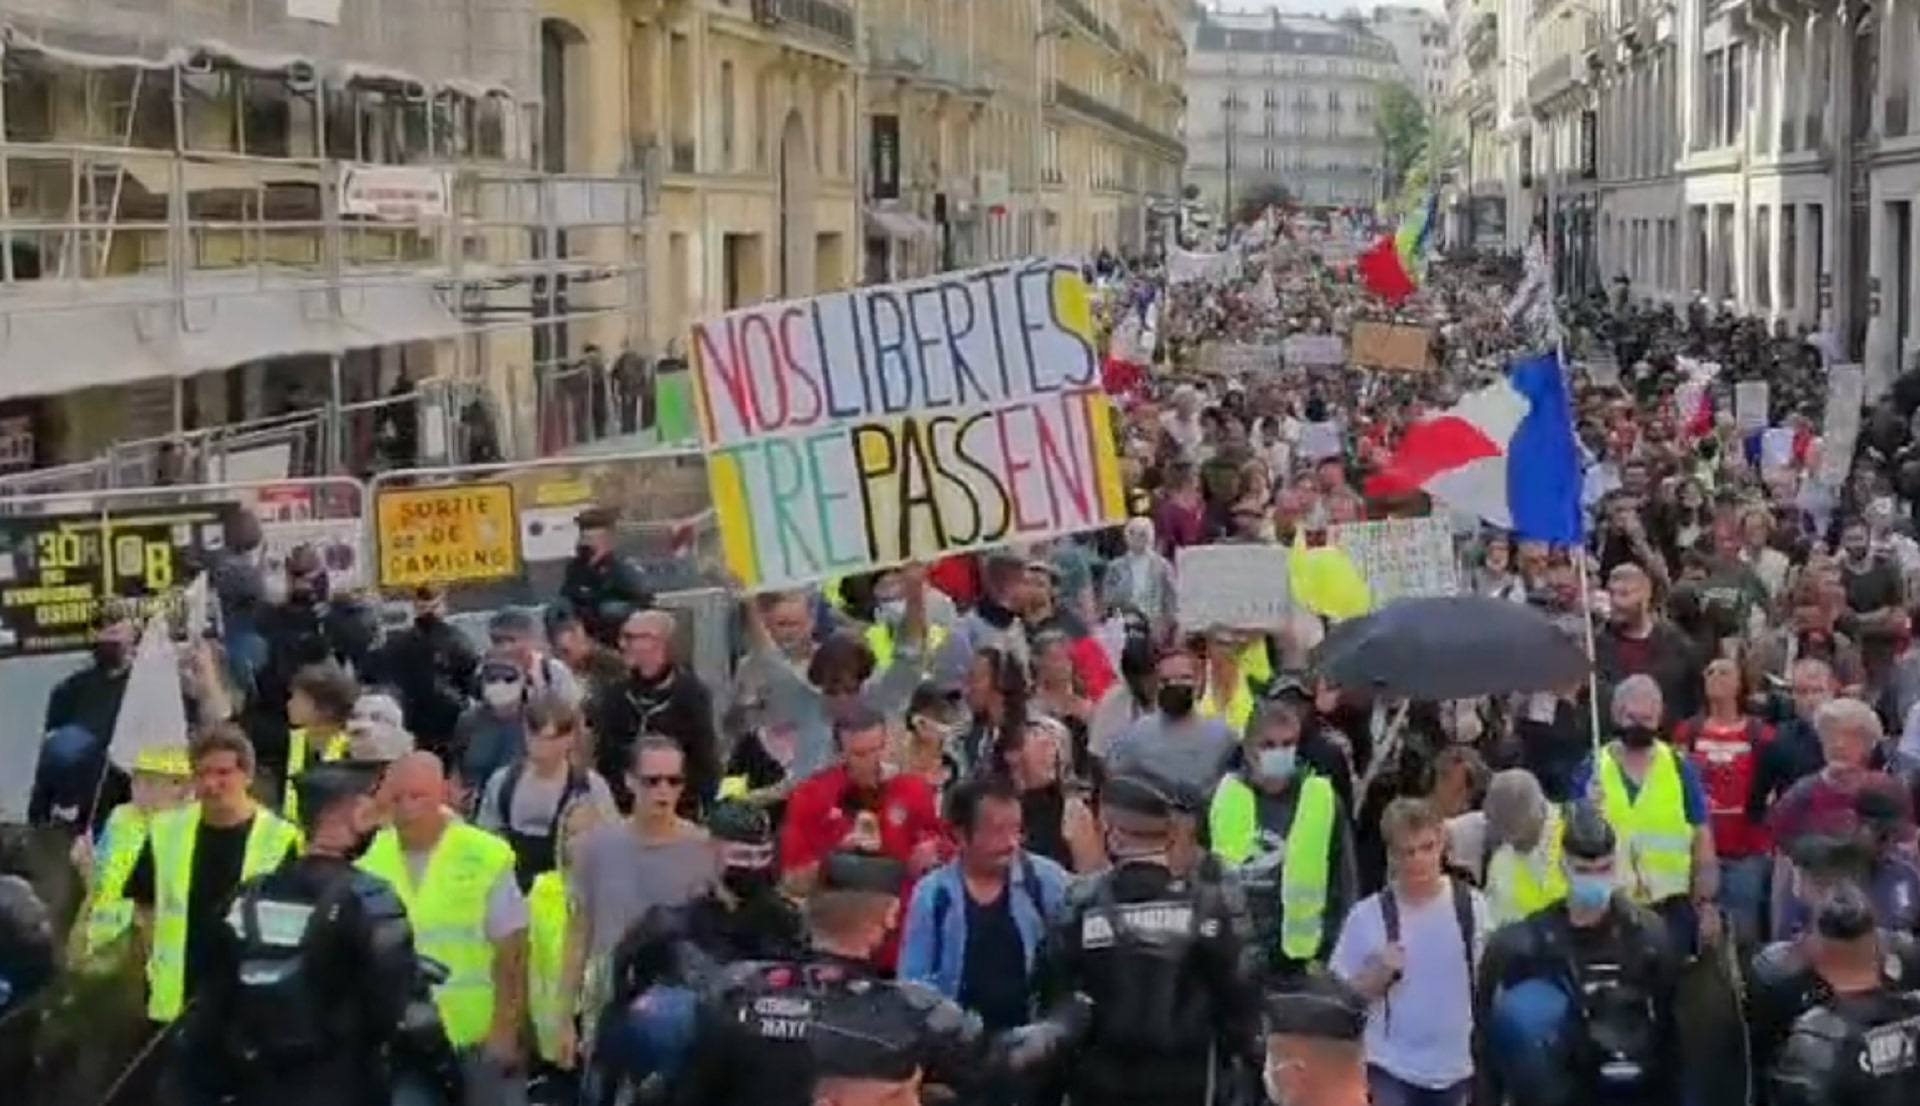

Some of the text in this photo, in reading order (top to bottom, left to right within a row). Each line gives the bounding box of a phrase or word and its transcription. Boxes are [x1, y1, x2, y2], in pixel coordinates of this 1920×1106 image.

[691, 256, 1094, 443] NOS LIBERTÉS
[399, 494, 489, 520] SORTIE
